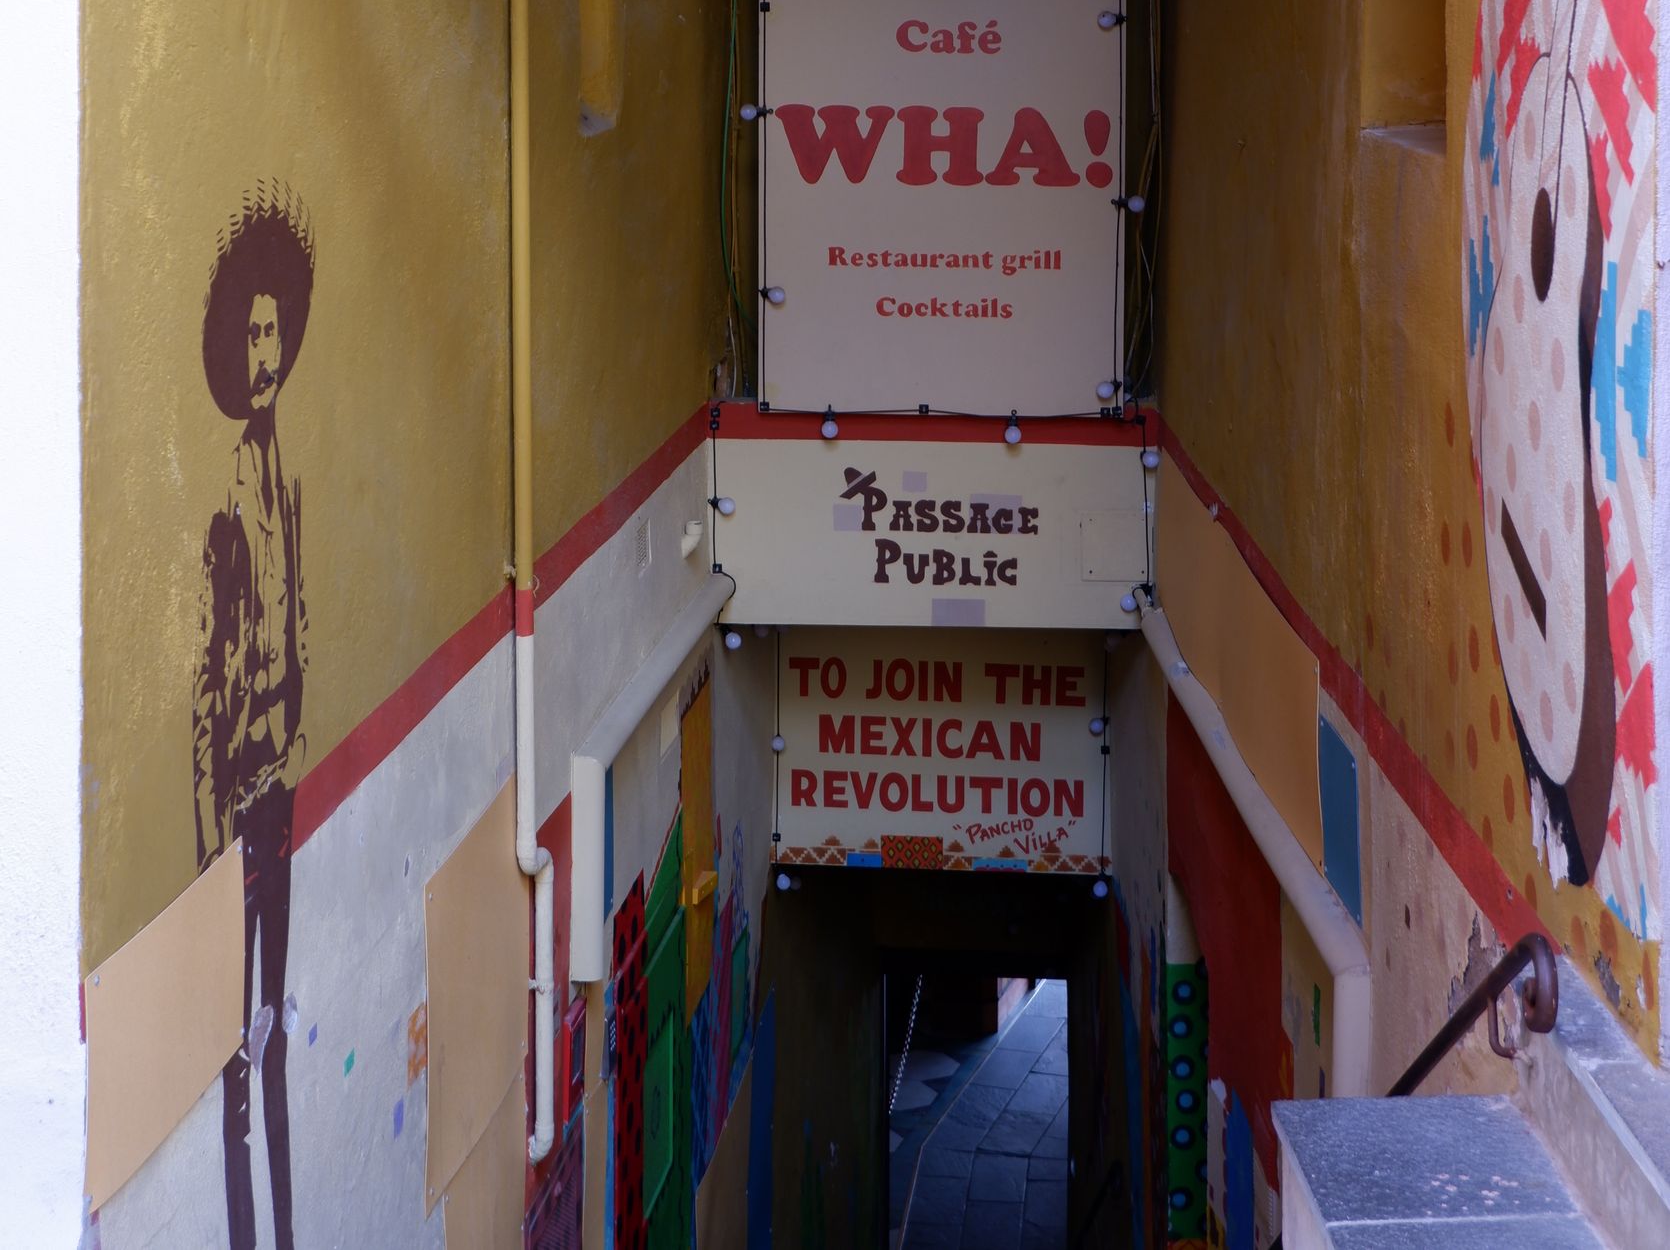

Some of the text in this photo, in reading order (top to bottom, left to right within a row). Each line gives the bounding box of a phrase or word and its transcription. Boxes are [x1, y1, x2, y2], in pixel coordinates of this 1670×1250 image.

[895, 19, 1003, 55] Café
[774, 103, 1114, 189] WHA!
[827, 246, 1062, 276] Restaurant grill
[875, 296, 1014, 319] Cocktails
[860, 485, 1039, 536] PASSAGE
[873, 537, 1018, 587] PUBLIC
[788, 656, 1087, 707] TO JOIN THE
[818, 713, 1042, 762] MEXICAN
[790, 768, 1085, 818] REVOLUTION
